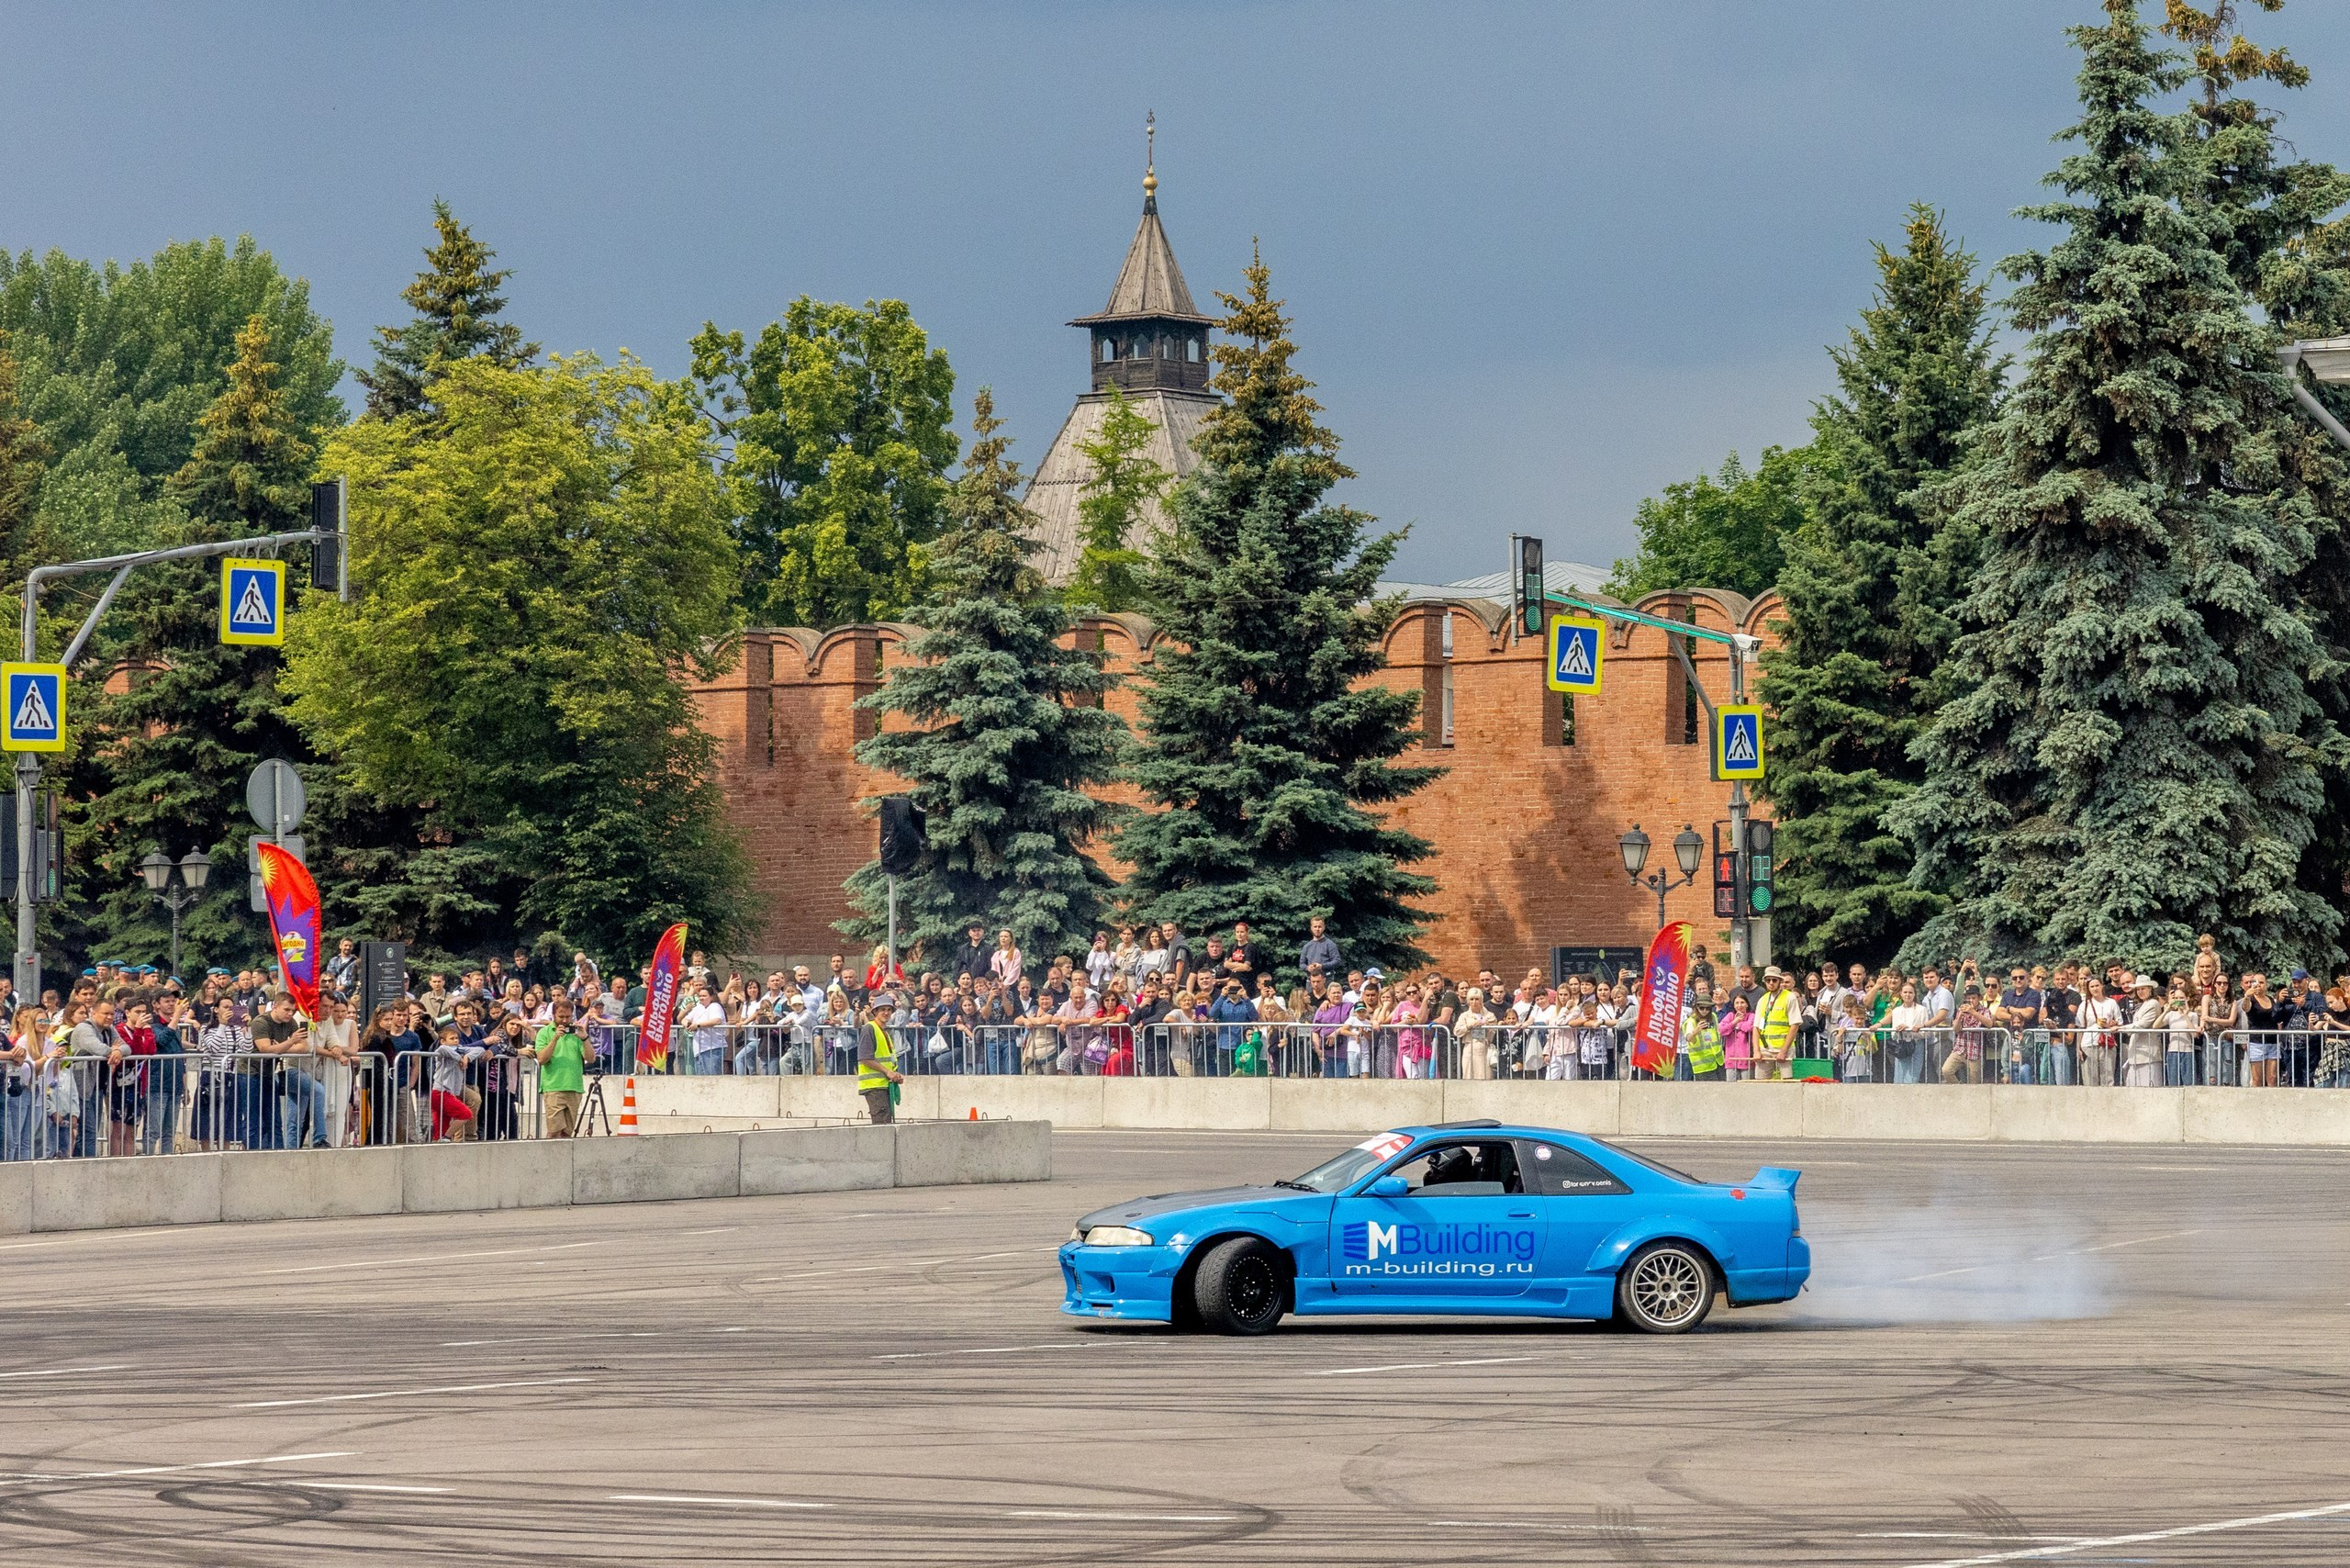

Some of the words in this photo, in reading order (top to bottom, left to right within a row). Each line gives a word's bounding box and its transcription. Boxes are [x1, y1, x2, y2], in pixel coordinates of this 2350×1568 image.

[1752, 856, 1771, 881] 02
[646, 990, 663, 1040] АЛЬФА
[654, 972, 674, 1044] ВЫГОДНО
[1647, 989, 1666, 1043] АЛЬФА
[1661, 971, 1680, 1048] ВЫГОДНО
[1346, 1260, 1533, 1276] m-building.ru
